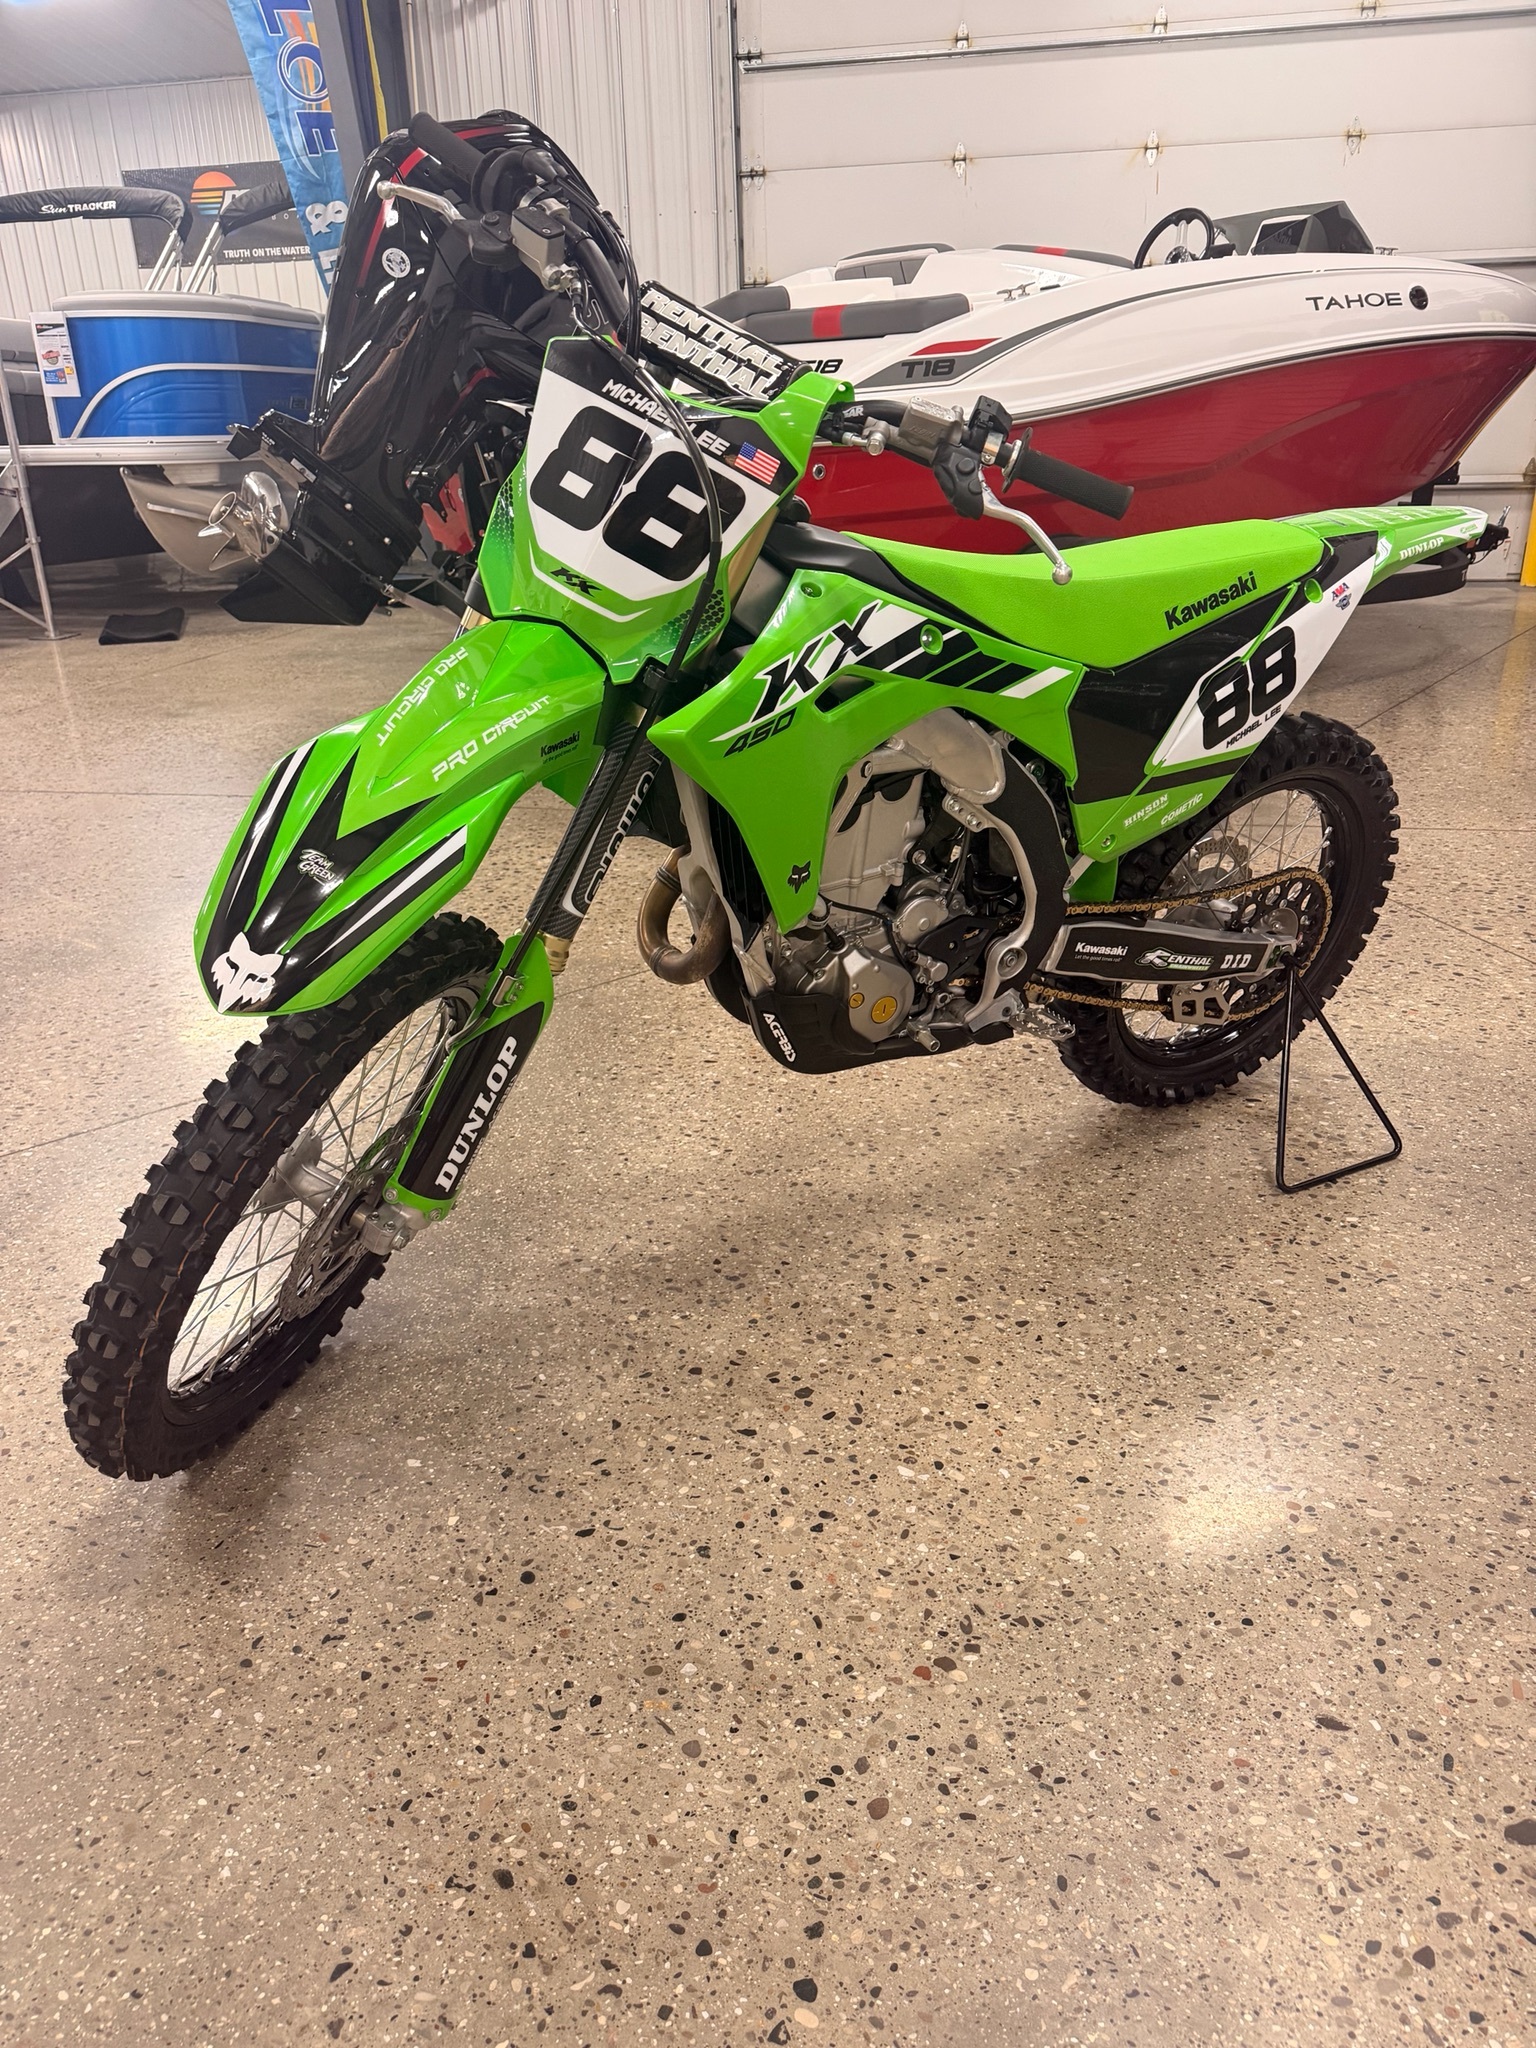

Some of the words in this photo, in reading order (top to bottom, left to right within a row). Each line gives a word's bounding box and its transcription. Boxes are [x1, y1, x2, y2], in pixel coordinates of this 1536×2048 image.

[67, 200, 117, 213] TRACKER
[223, 249, 251, 258] TRUTH
[252, 248, 265, 257] ON
[265, 247, 281, 256] THE
[281, 246, 311, 255] WATER
[1305, 292, 1403, 311] TAHOE
[640, 287, 783, 377] RENTHAL
[640, 312, 779, 400] RENTHAL
[810, 358, 844, 374] 18
[901, 358, 956, 379] T18
[529, 405, 747, 582] 88
[1399, 536, 1445, 560] DUNLOP
[550, 566, 602, 597] KX
[1331, 582, 1350, 602] AMA
[1164, 570, 1258, 631] Kawasaki
[434, 646, 469, 677] PRO
[749, 601, 880, 724] KX
[1197, 625, 1297, 750] 88
[376, 675, 436, 748] CIRCUIT
[1225, 719, 1263, 749] MICHAEL
[1264, 703, 1282, 722] LEE
[431, 739, 479, 783] PRO
[481, 694, 551, 745] CIRCUIT
[540, 730, 580, 758] Kawasaki
[723, 706, 798, 759] 450
[1123, 793, 1169, 828] HINSON
[1160, 792, 1204, 826] COMETIC
[1074, 941, 1129, 956] Kawasaki
[1220, 954, 1253, 970] DID
[434, 1035, 518, 1193] DUNLOP
